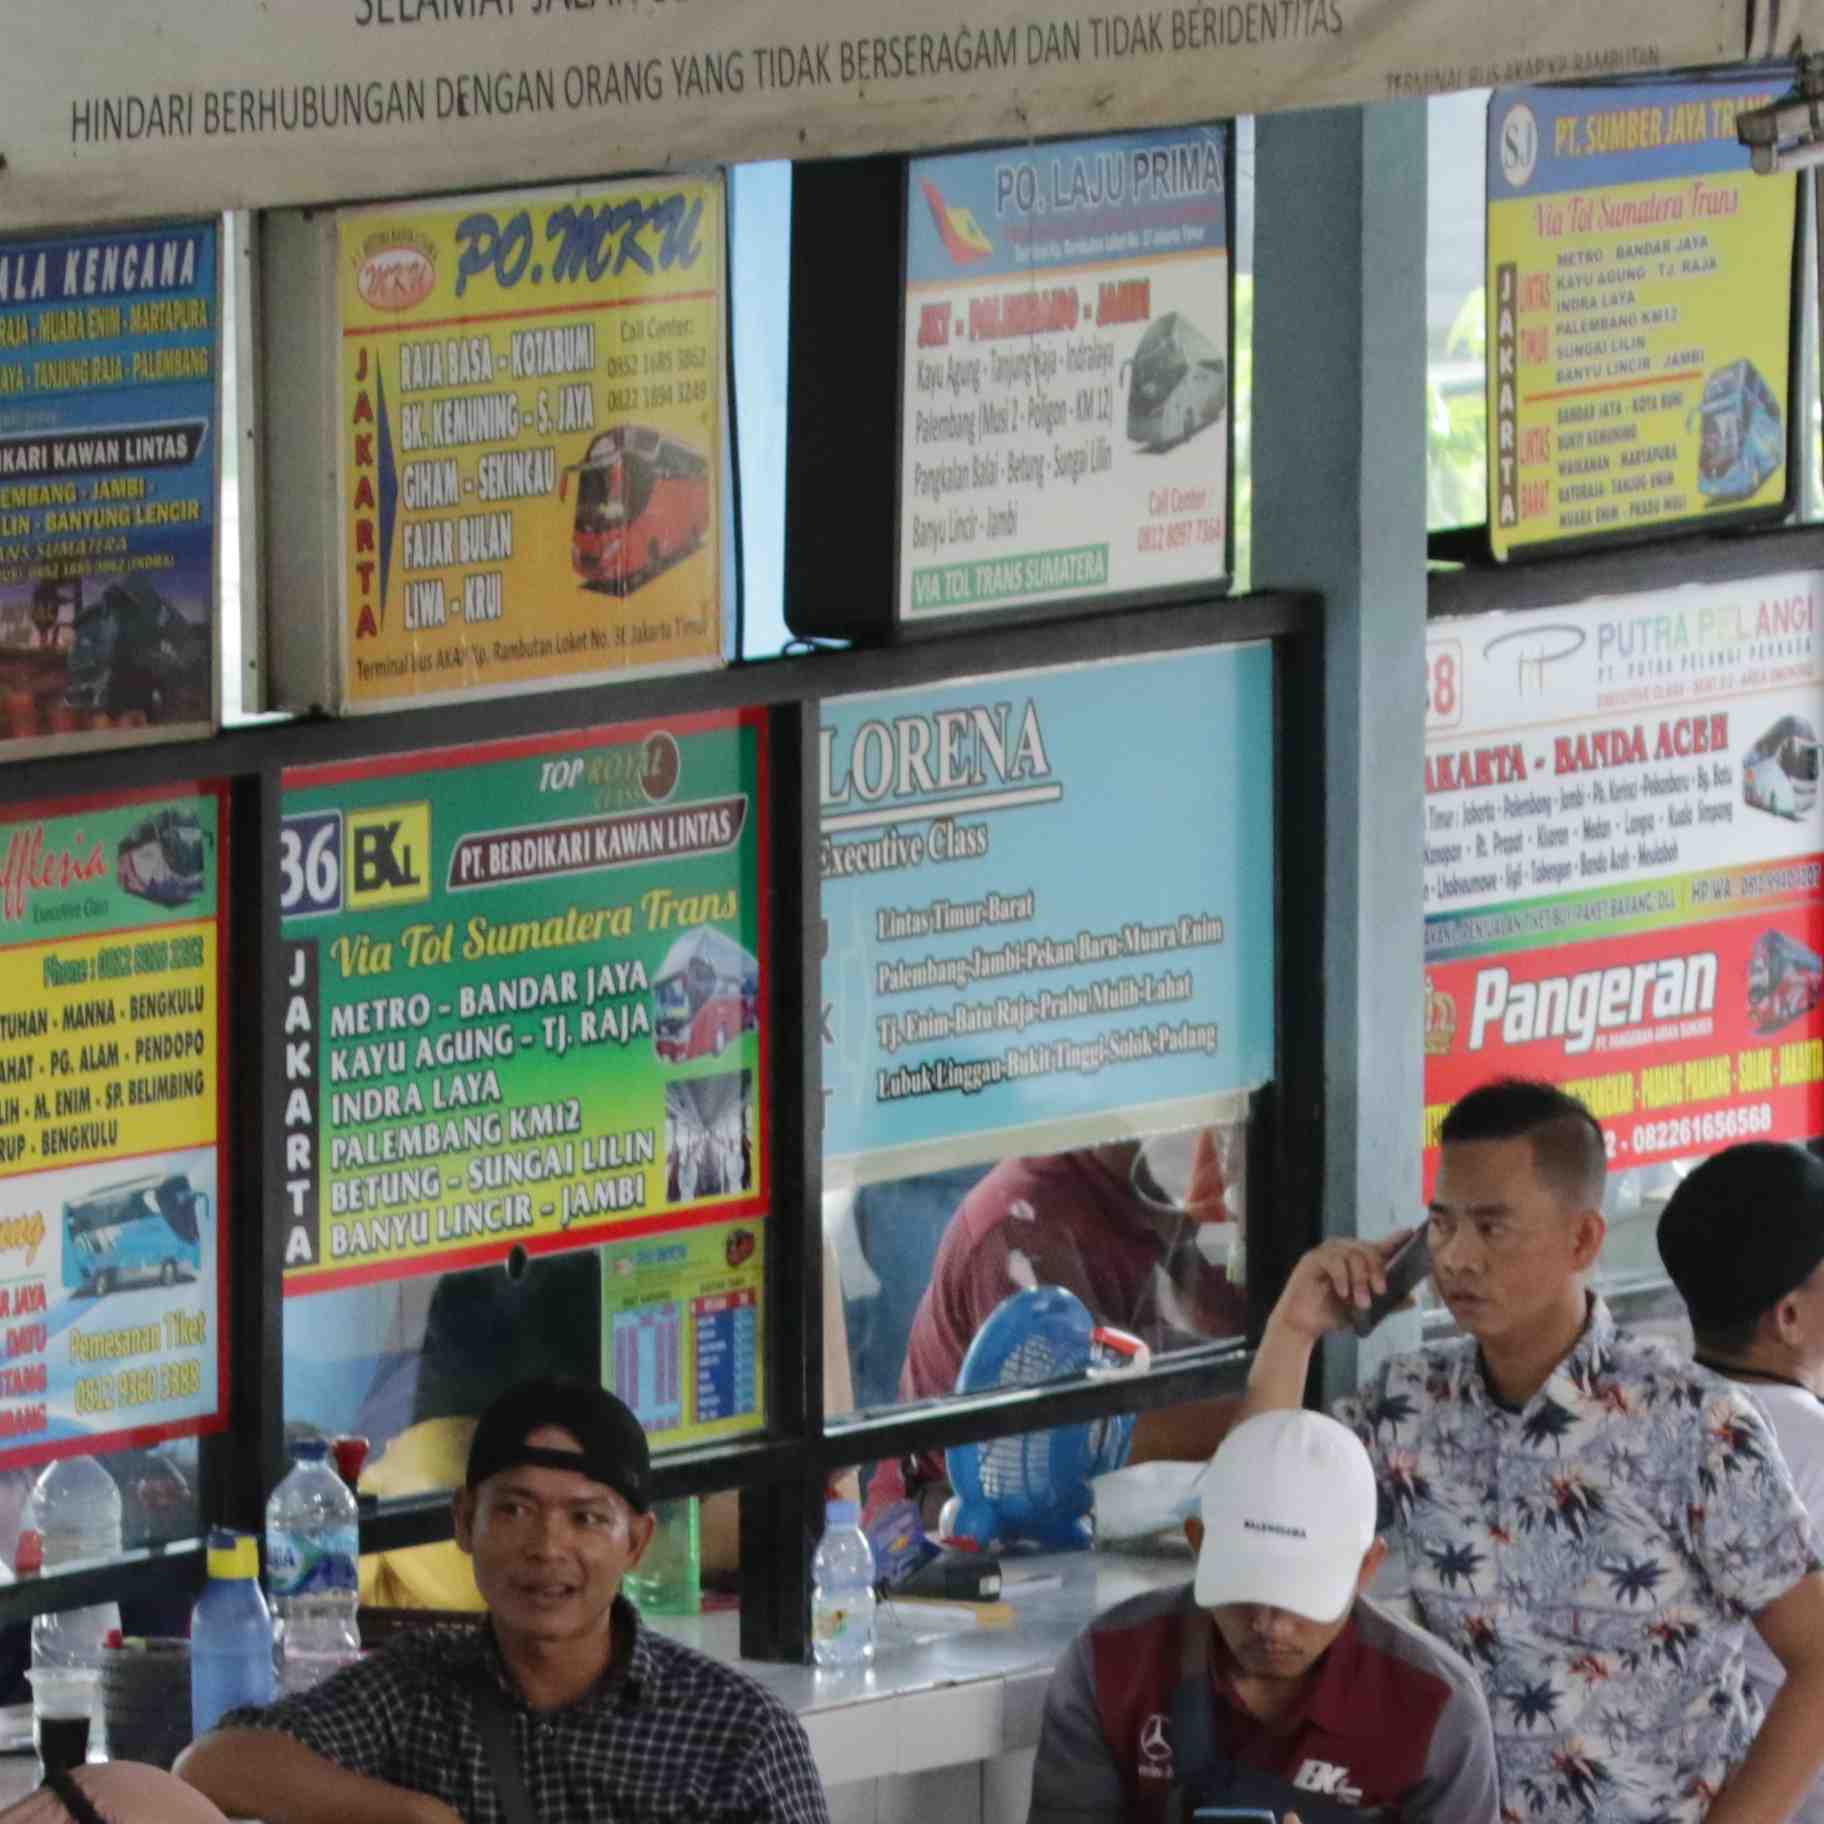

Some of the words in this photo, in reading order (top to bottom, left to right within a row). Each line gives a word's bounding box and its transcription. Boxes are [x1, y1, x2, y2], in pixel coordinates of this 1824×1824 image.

[72, 99, 194, 144] HINDARI
[203, 79, 424, 133] BERHUBUNGAN
[435, 70, 555, 120] DENGAN
[564, 58, 661, 109] ORANG
[672, 52, 744, 98] YANG
[754, 41, 830, 90] TIDAK
[840, 24, 1019, 83] BERSERAGAM
[1025, 19, 1081, 64] DAN
[1090, 13, 1163, 56] TIDAK
[1171, 0, 1343, 47] BERIDENTITAS
[64, 240, 195, 296] KENCANA
[53, 439, 119, 468] KAWAN
[125, 433, 187, 461] LINTAS
[539, 759, 584, 792] TOP
[820, 698, 1050, 803] LORENA
[1555, 727, 1649, 776] BANDA
[1654, 713, 1729, 760] ACEH
[461, 847, 485, 881] PT.
[489, 830, 591, 876] BERDIKARI
[595, 818, 663, 859] KAWAN
[669, 807, 731, 847] LINTAS
[331, 934, 391, 978] Via
[401, 920, 452, 966] Tol
[463, 903, 632, 956] Sumatera
[641, 887, 738, 928] Trans
[64, 998, 115, 1030] MANNA
[130, 985, 204, 1019] BENGKULU
[330, 992, 429, 1039] METRO
[459, 973, 577, 1019] BANDAR
[587, 960, 647, 996] JAYA
[1469, 952, 1717, 1055] Pangeran
[331, 1081, 422, 1126] INDRA
[433, 1070, 500, 1110] LAYA
[40, 1120, 117, 1155] BENGKULU
[330, 1110, 501, 1169] PALEMBANG
[331, 1164, 439, 1213] BETUNG
[469, 1142, 573, 1190] SUNGAI
[584, 1130, 654, 1168] LILIN
